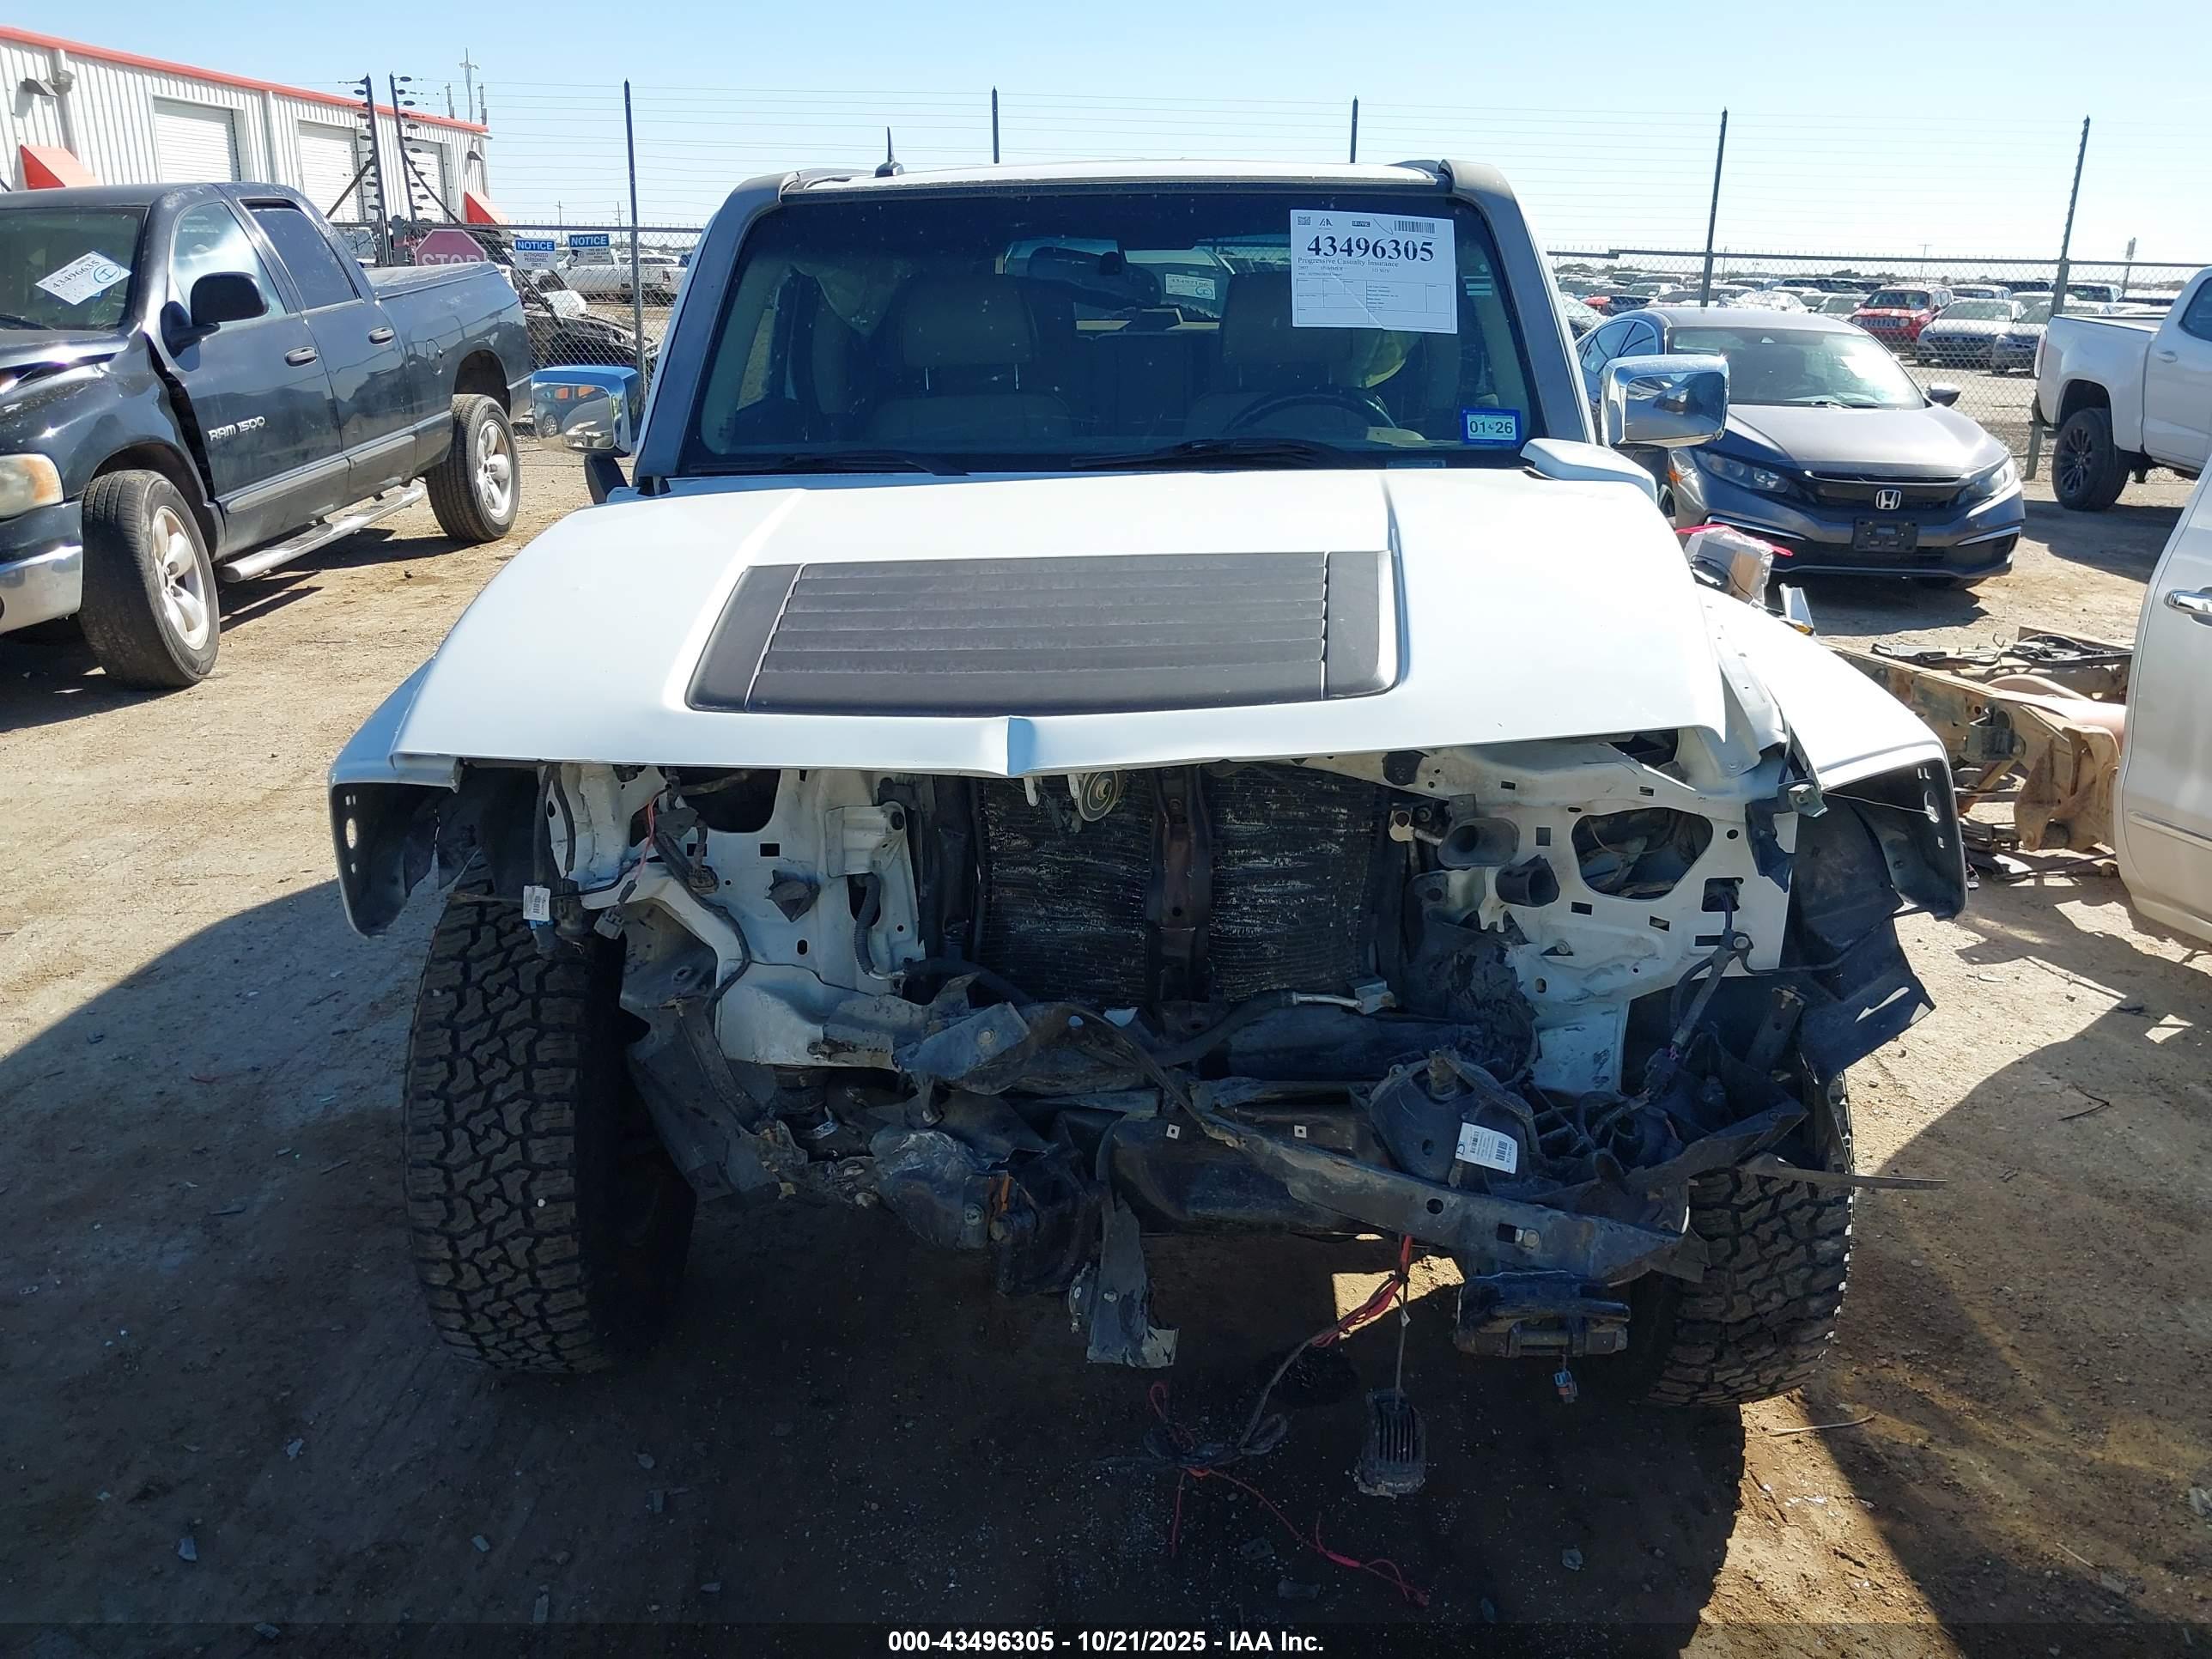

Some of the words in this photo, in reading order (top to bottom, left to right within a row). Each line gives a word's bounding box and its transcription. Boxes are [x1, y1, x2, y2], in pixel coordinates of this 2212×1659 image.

[517, 241, 553, 250] NOTICE
[571, 236, 607, 246] NOTICE
[1307, 235, 1434, 262] 43496305
[1337, 258, 1365, 267] Casualty
[52, 259, 100, 289] 43496635
[208, 424, 236, 441] RAM
[236, 416, 265, 433] 1500
